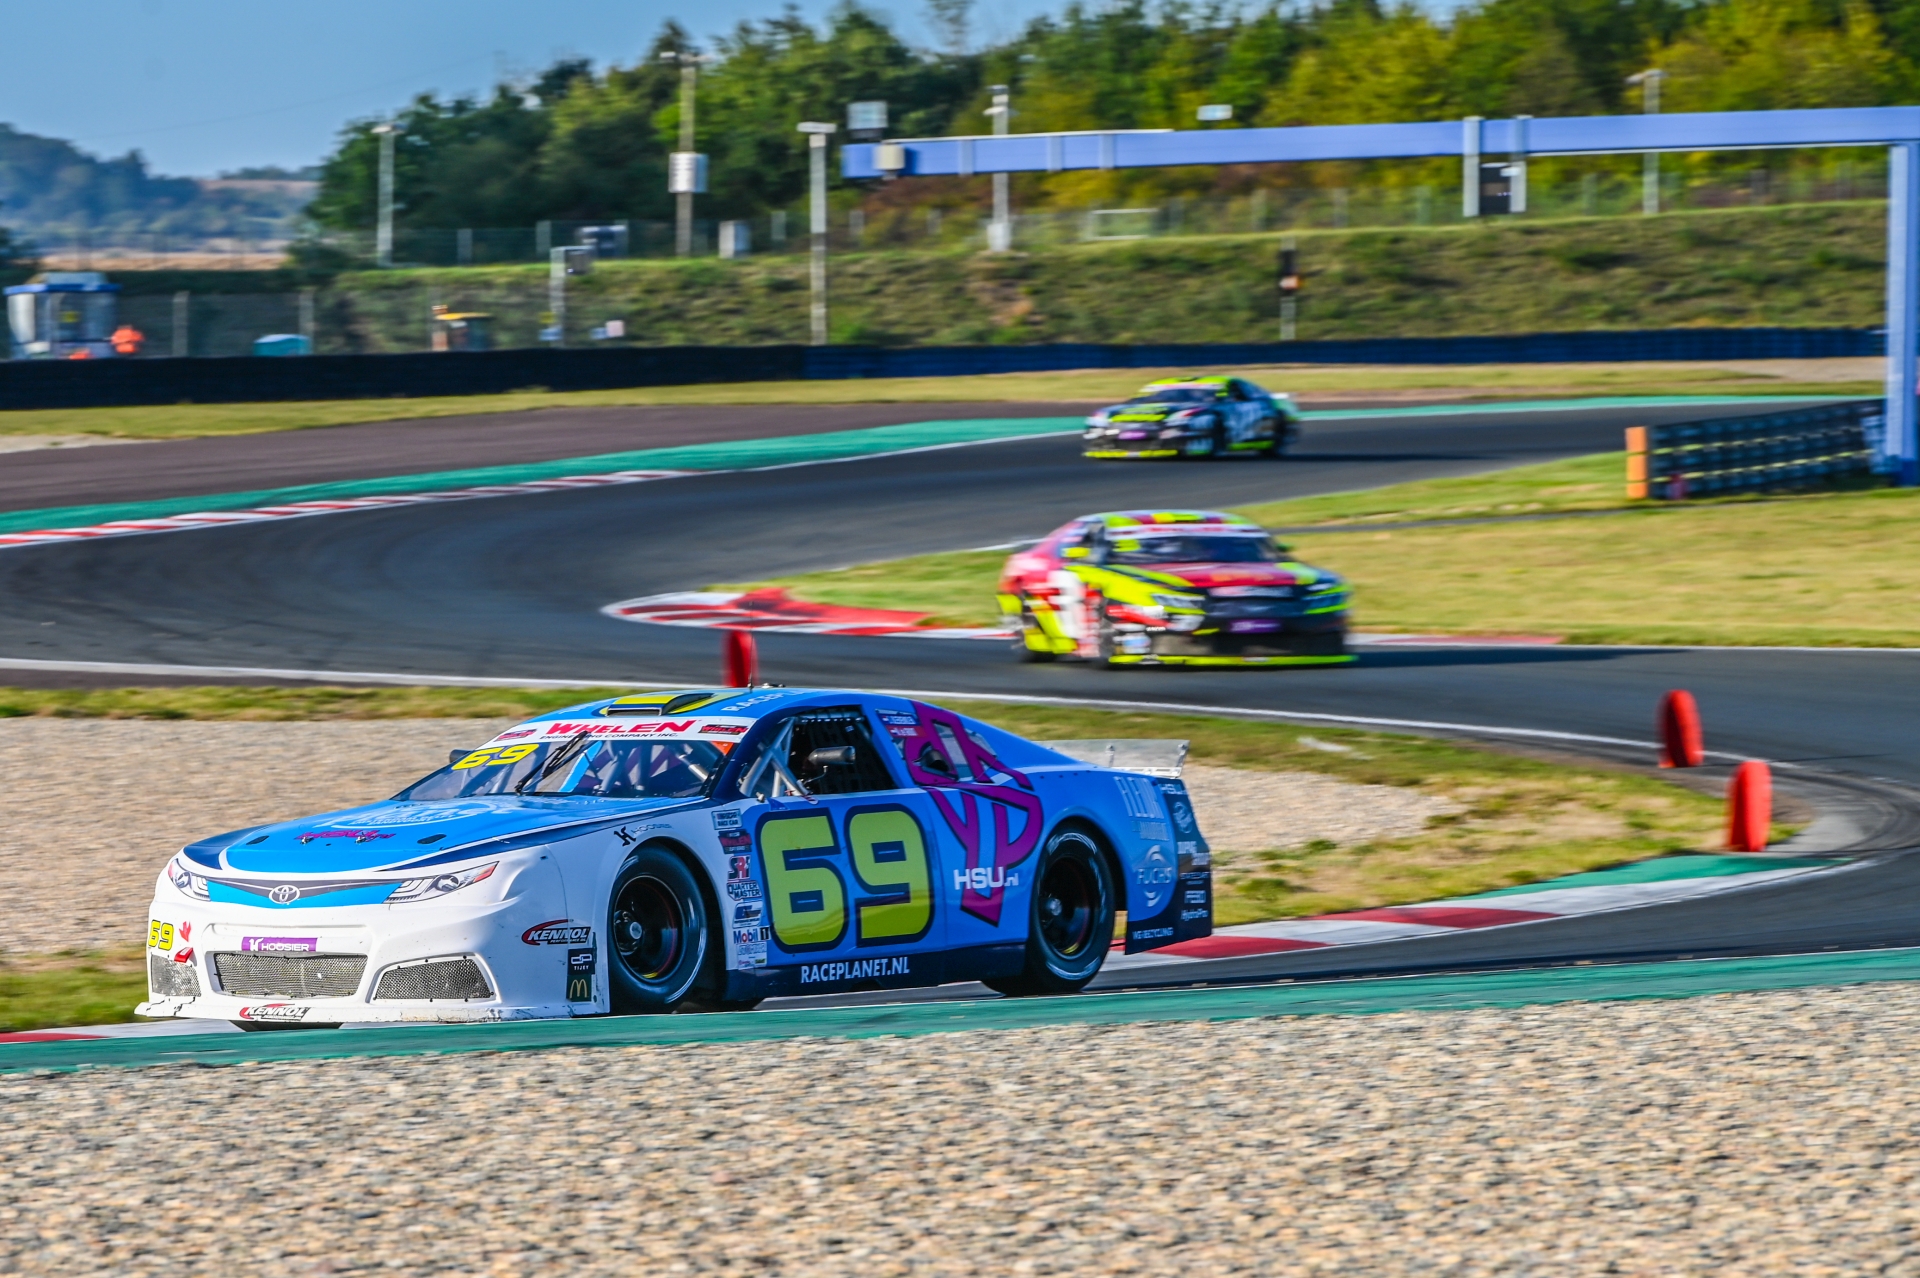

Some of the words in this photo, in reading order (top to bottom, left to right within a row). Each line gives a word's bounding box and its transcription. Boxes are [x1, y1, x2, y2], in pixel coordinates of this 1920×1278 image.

[546, 720, 696, 735] WHELEN
[451, 743, 540, 770] 69
[756, 804, 935, 952] 69
[953, 866, 1019, 890] HSU.nl
[1136, 867, 1173, 884] FUCHS
[727, 882, 759, 896] QUARTER
[733, 889, 761, 900] MASTER
[148, 919, 174, 951] 69
[527, 927, 588, 941] KENNOL
[733, 929, 758, 944] Mobil
[261, 943, 310, 951] HOOSIER
[800, 956, 910, 983] RACEPLANET.NL
[244, 1006, 307, 1018] KENNOL
